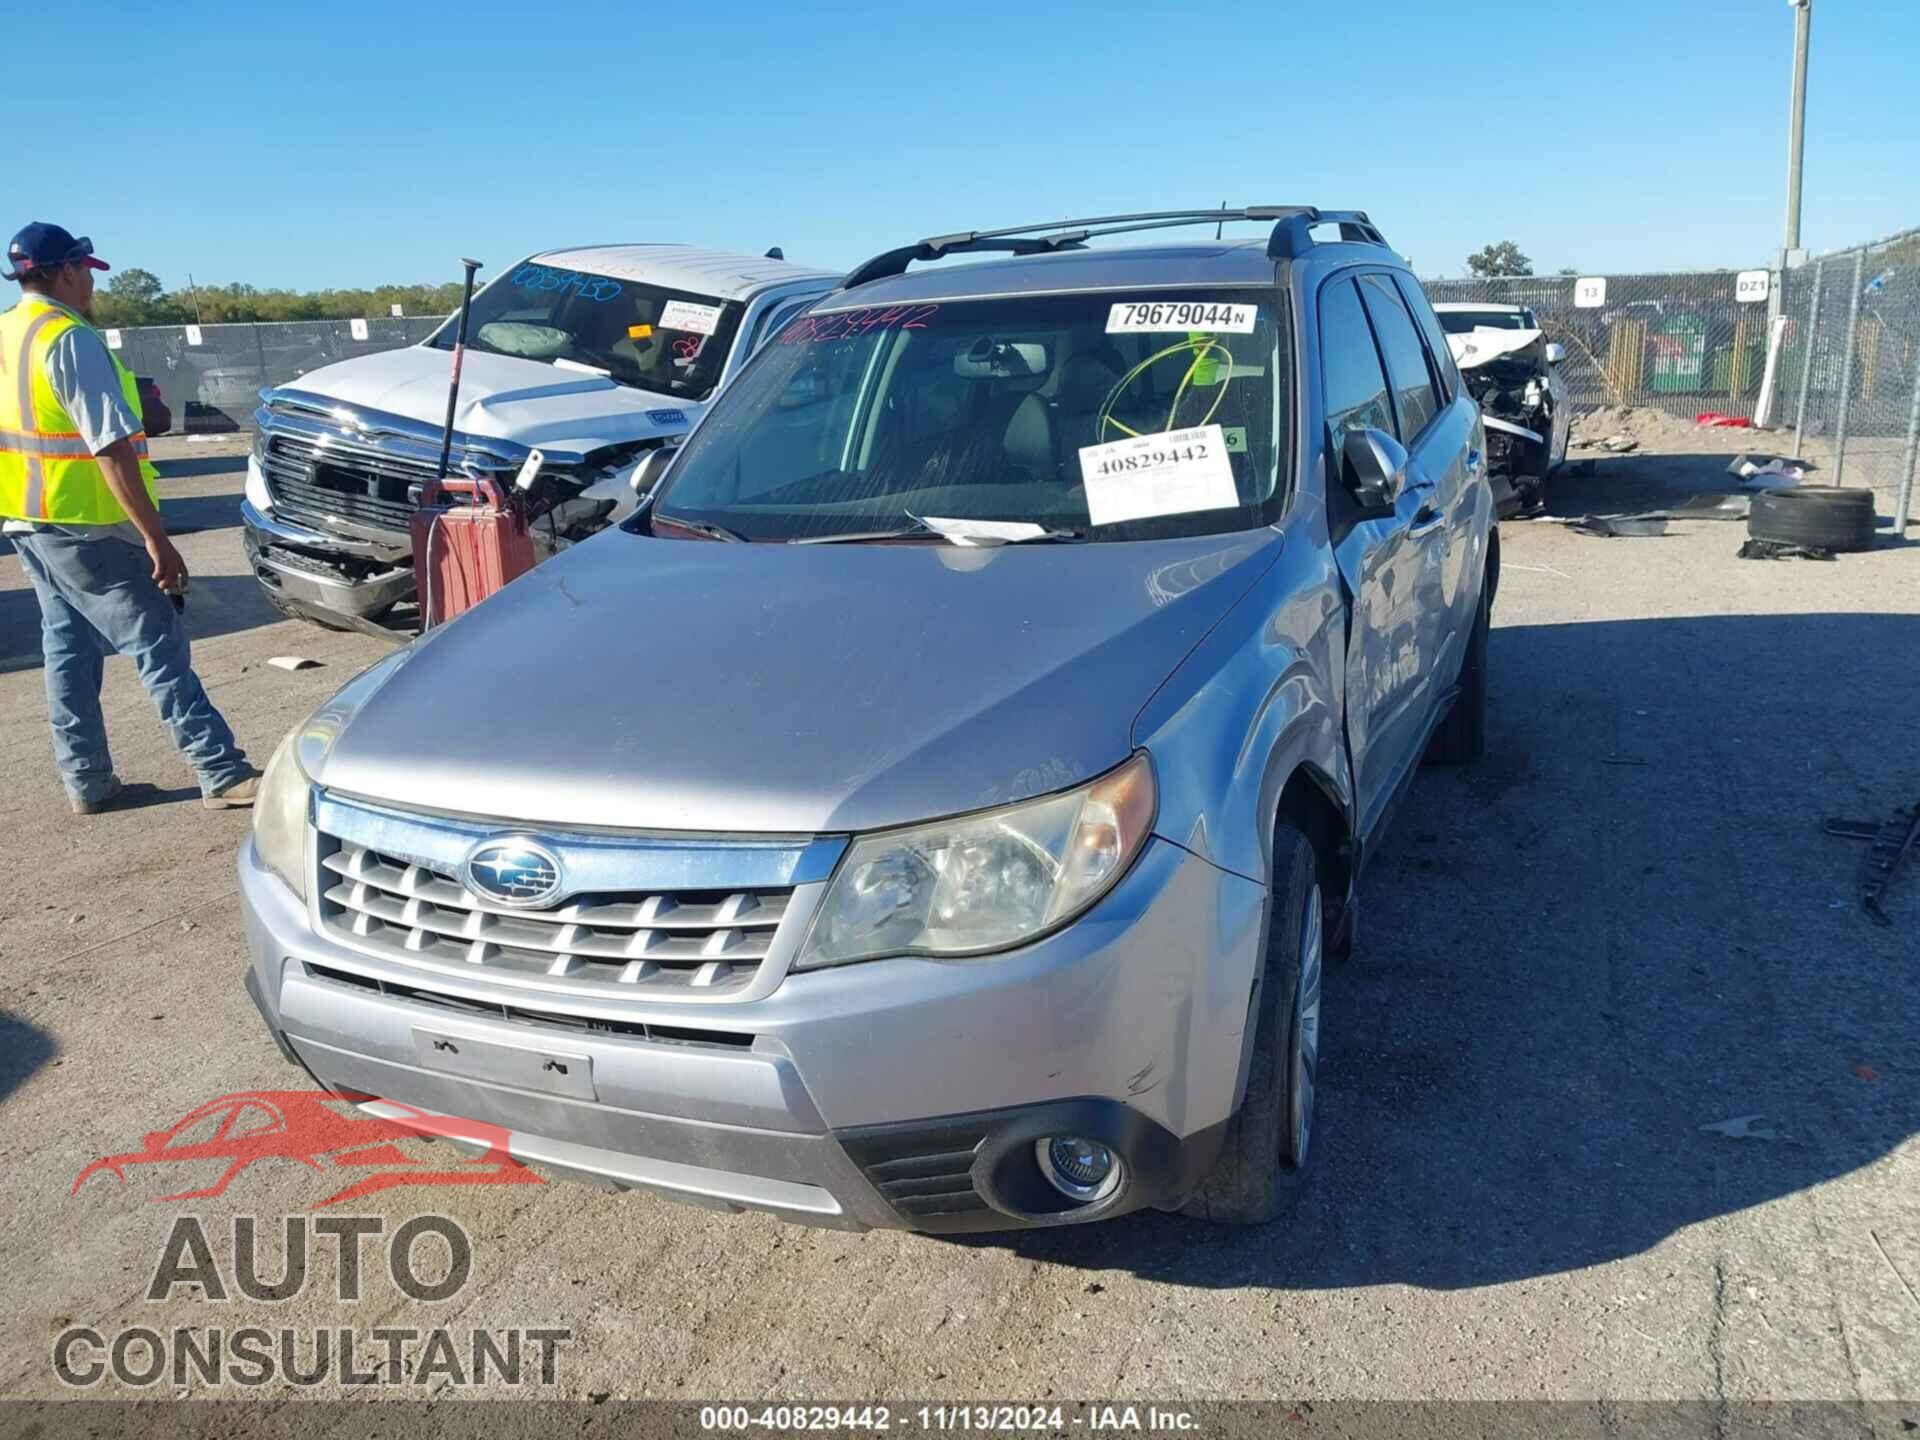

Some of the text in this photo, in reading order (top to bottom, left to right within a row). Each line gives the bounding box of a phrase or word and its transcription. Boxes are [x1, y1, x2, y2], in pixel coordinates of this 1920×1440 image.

[1583, 285, 1599, 299] 13
[1739, 280, 1767, 295] DZ1
[1123, 304, 1245, 325] 79679044 N
[1098, 445, 1208, 475] 40829442
